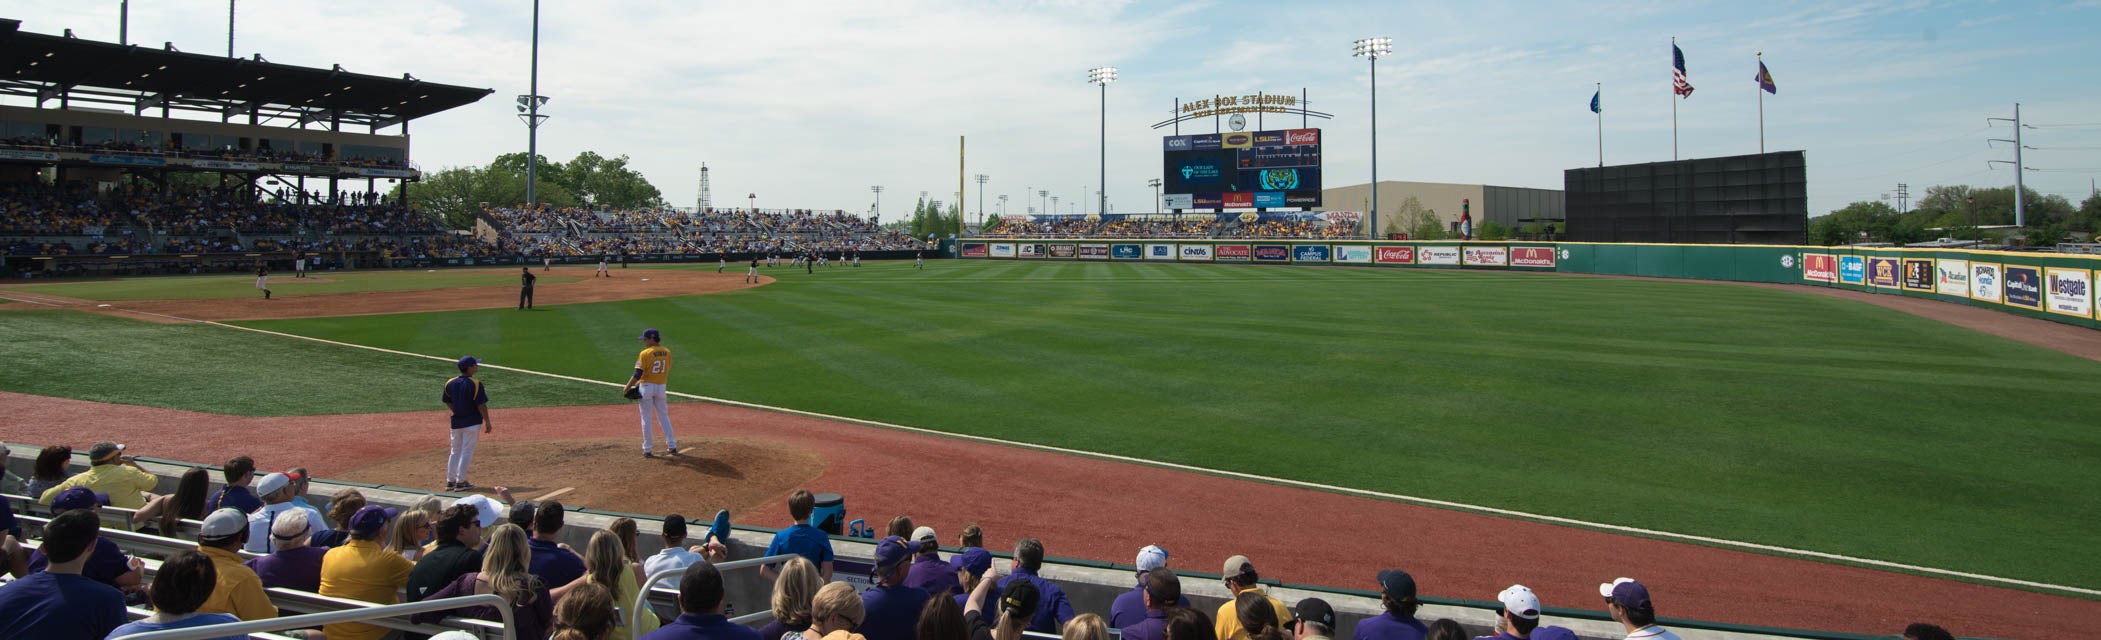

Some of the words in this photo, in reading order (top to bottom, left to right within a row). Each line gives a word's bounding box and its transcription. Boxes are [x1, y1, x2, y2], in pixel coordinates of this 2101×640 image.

[1183, 99, 1210, 113] ALEX
[1214, 96, 1237, 107] BOX
[1242, 94, 1296, 106] STADIUM
[1325, 211, 1359, 220] MANDA
[1848, 262, 1863, 271] BASF
[1807, 269, 1835, 278] McDonald's
[2050, 274, 2086, 297] Westgate
[651, 359, 666, 374] 21
